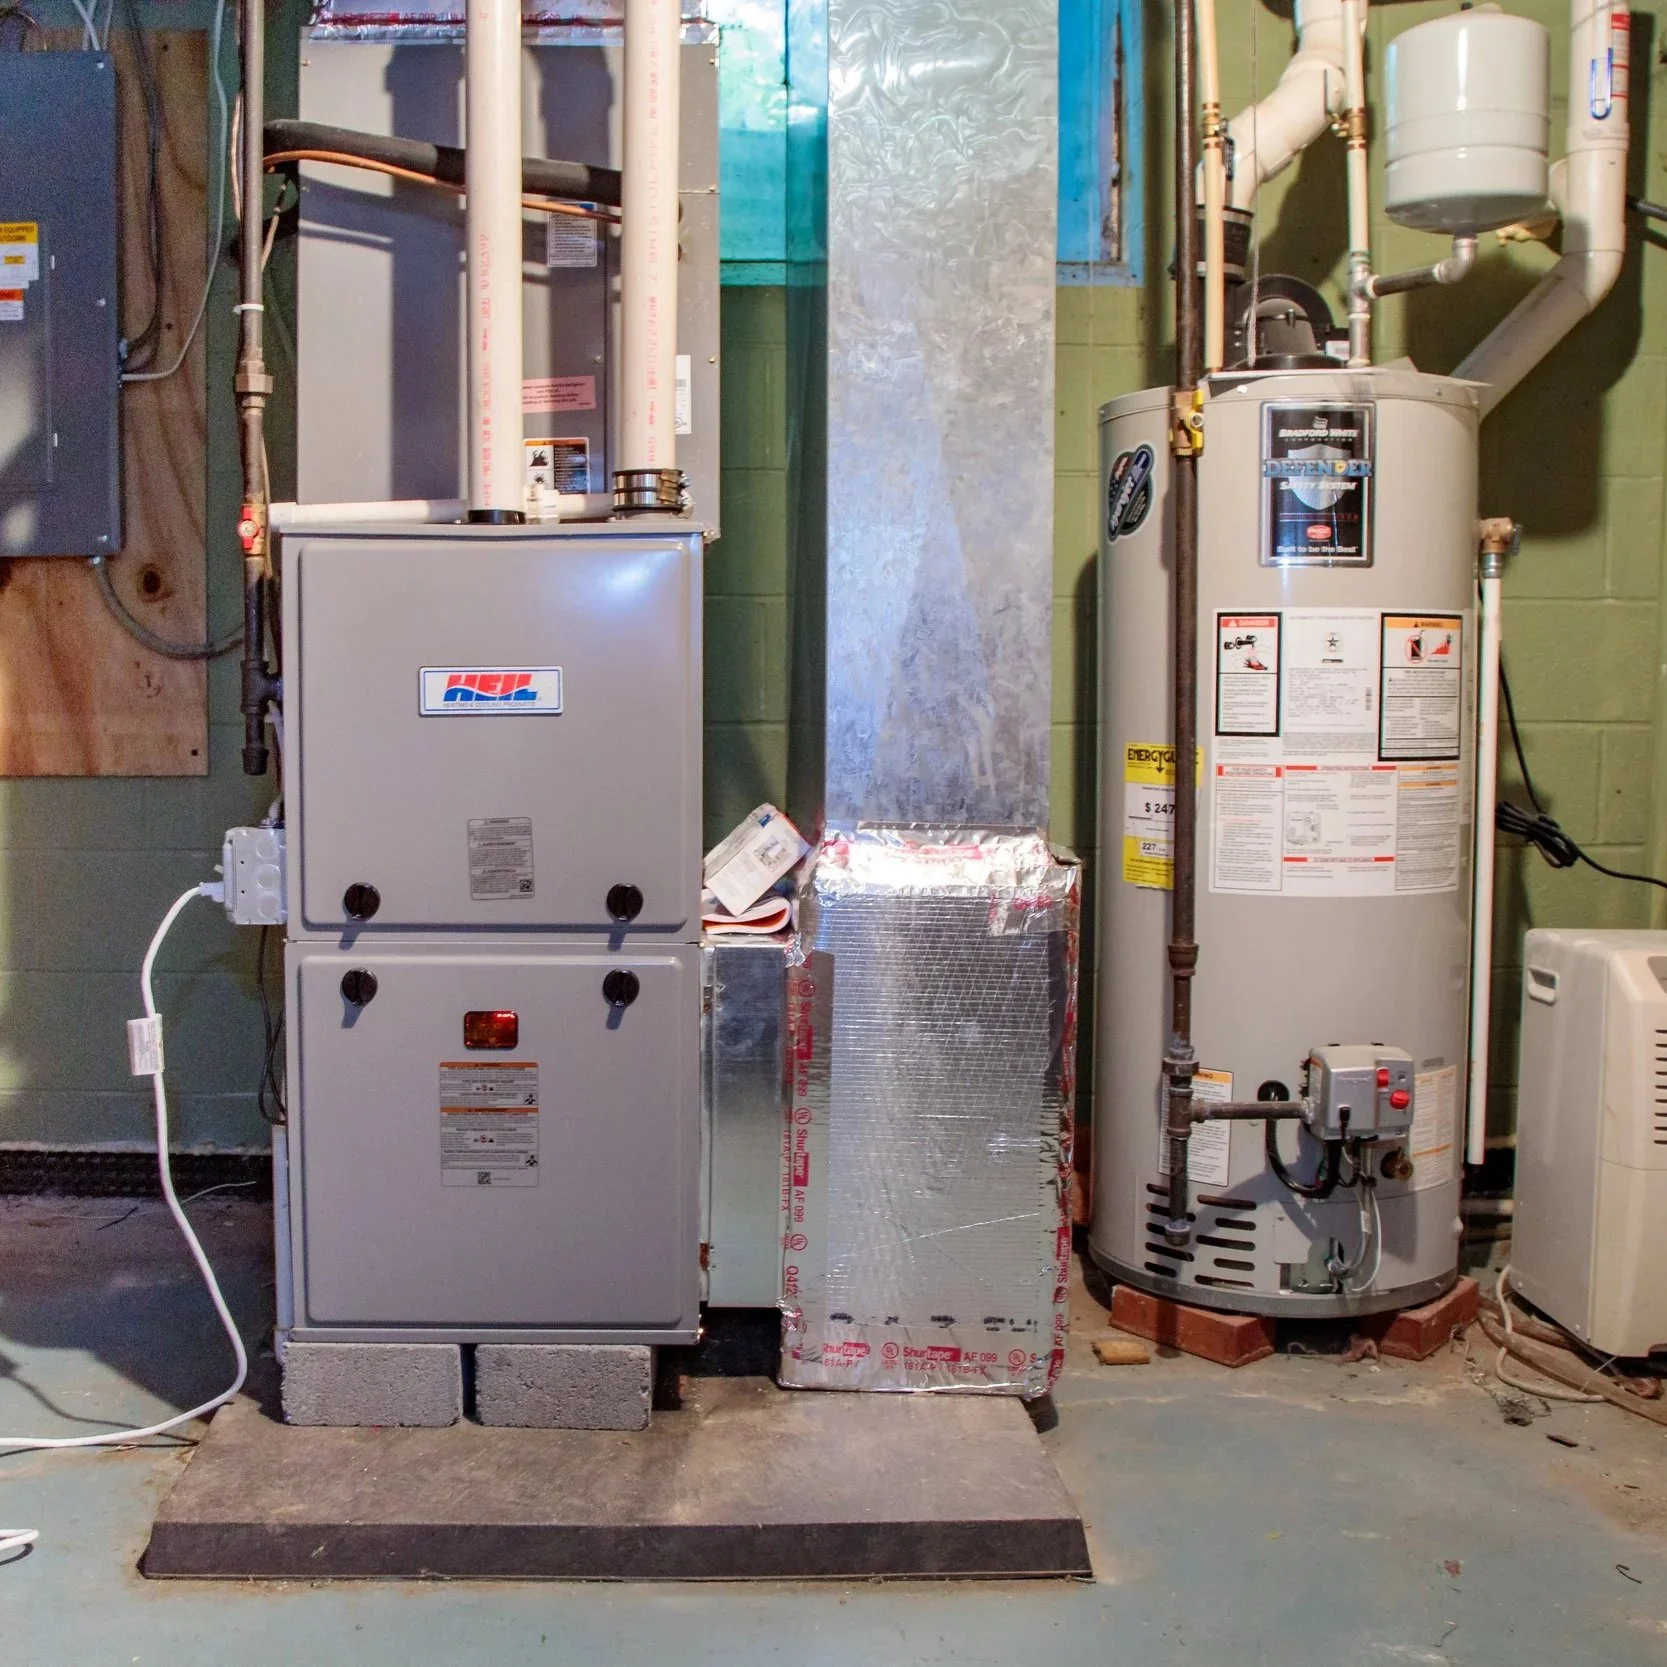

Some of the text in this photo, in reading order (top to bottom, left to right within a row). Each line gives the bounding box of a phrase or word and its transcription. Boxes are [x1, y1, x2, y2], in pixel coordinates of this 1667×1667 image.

[1279, 429, 1359, 438] BRADFORD WHITE
[1264, 459, 1373, 477] DEFENDER
[443, 673, 538, 702] HEIL
[1145, 802, 1175, 815] $ 247
[1142, 842, 1157, 851] 227
[793, 1128, 809, 1223] Shurtape AF 099
[1056, 1235, 1070, 1283] Shurtape
[1054, 1334, 1064, 1346] AF
[904, 1346, 998, 1363] Shurtape AF 099
